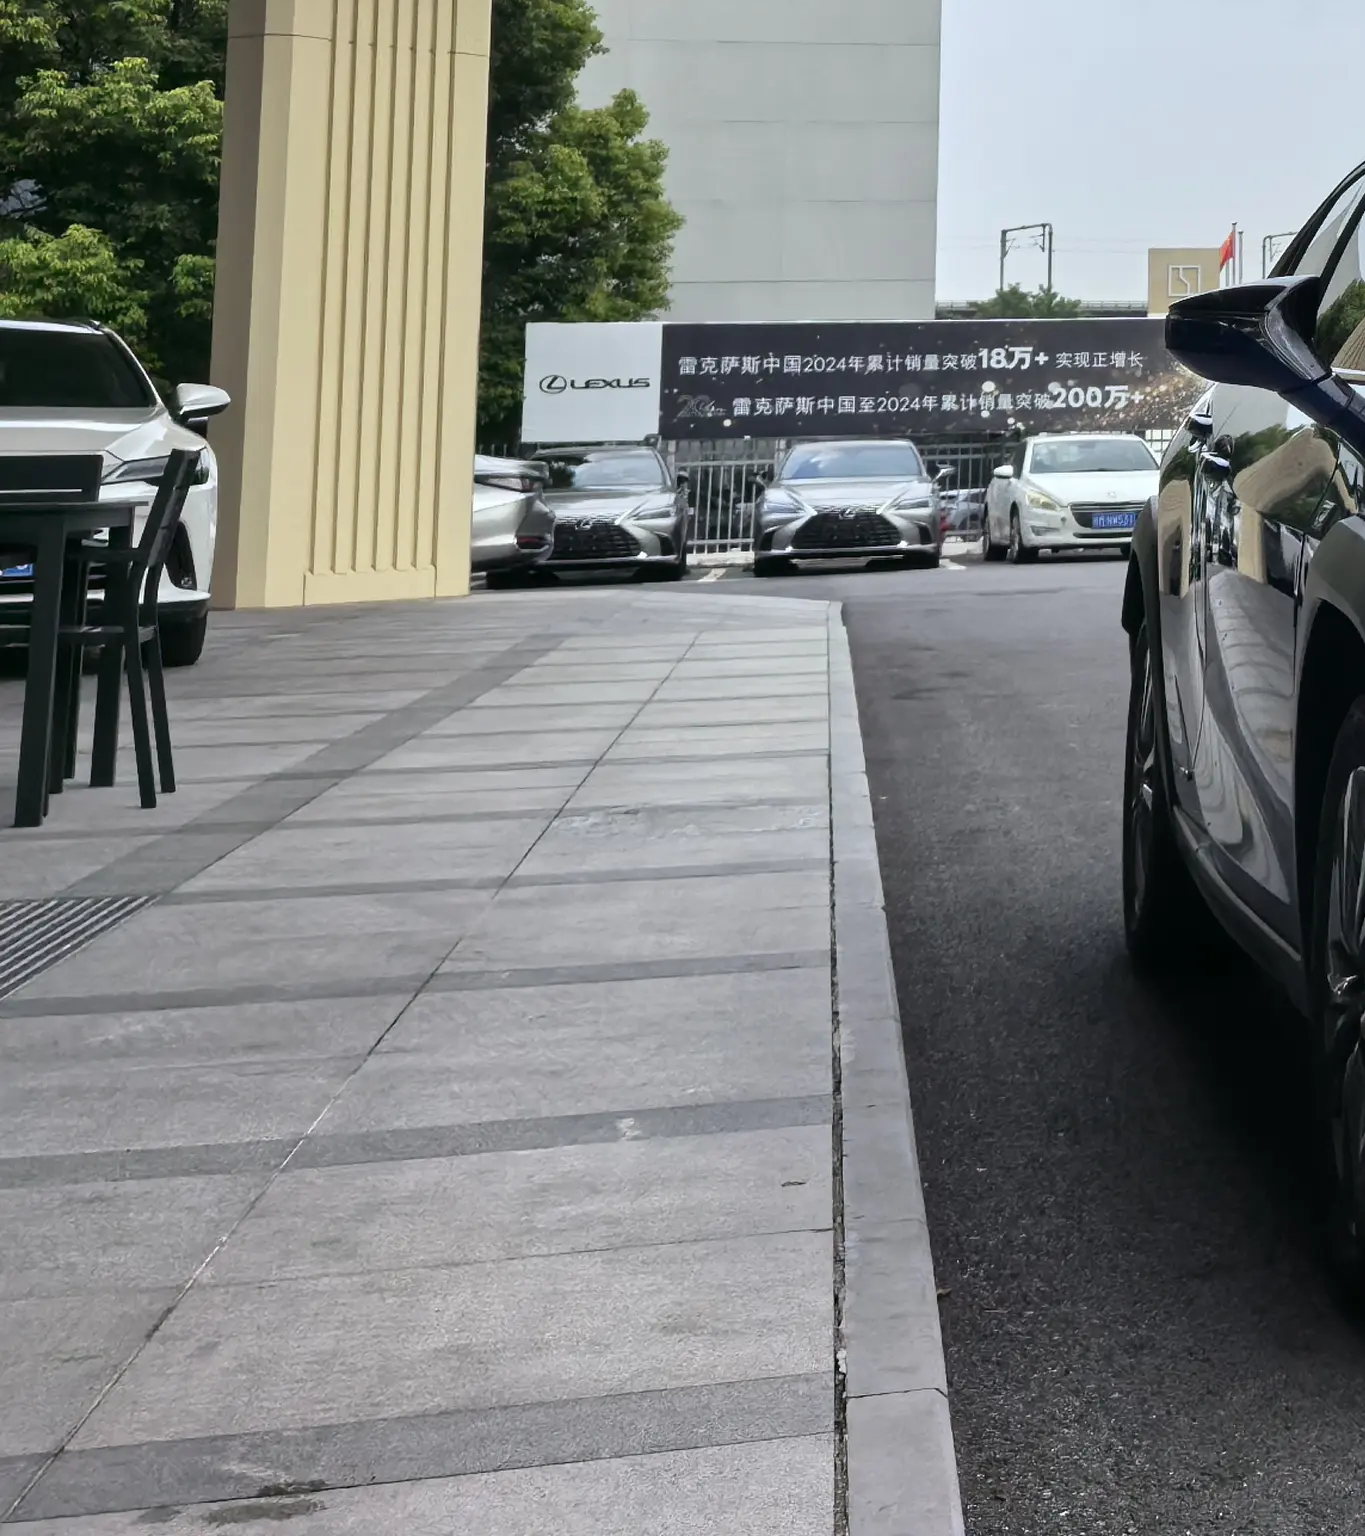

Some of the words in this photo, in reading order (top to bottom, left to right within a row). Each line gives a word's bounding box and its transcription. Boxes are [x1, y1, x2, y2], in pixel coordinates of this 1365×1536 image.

[1055, 352, 1143, 369] 实现正增长
[570, 378, 650, 389] LEXUS
